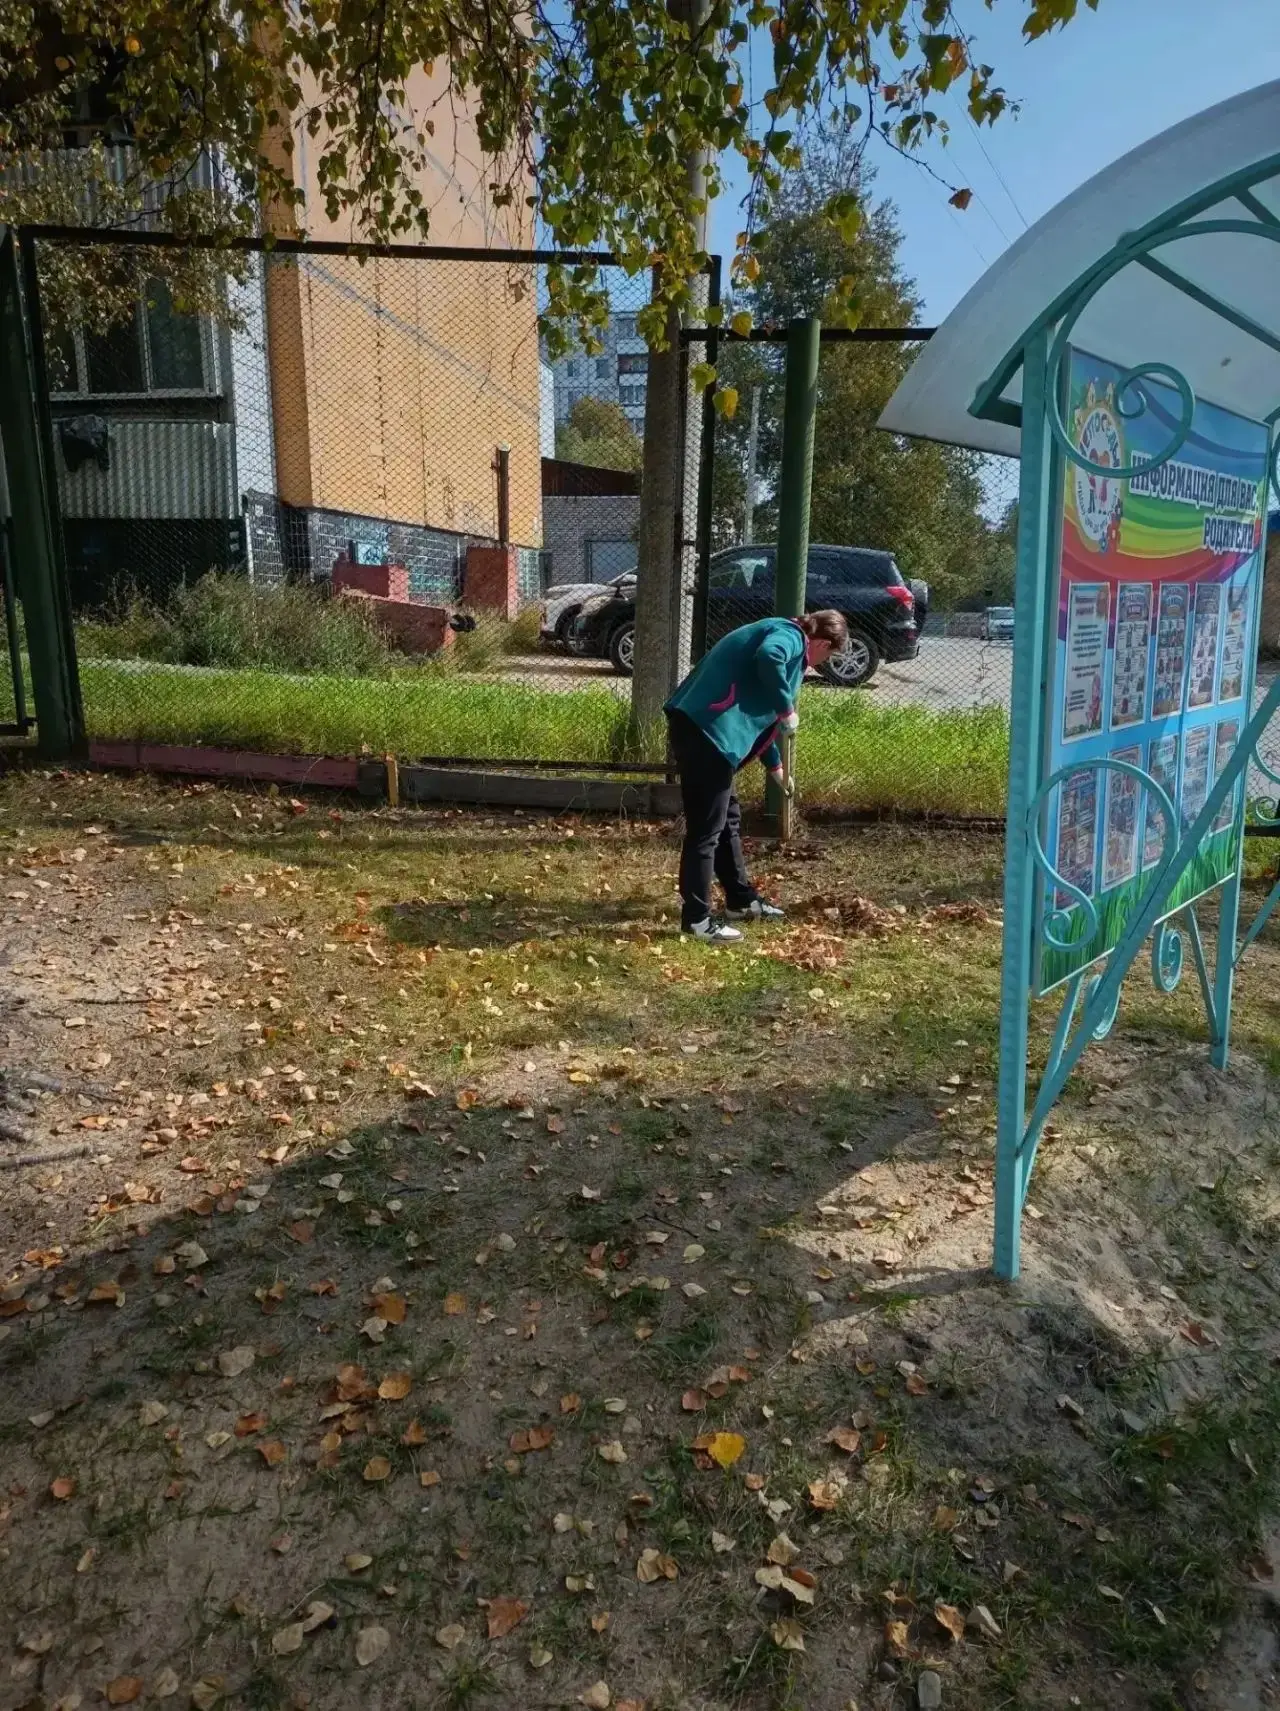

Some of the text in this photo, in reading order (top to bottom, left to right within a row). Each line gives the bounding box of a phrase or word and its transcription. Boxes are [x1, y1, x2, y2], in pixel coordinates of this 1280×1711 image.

[1131, 453, 1216, 508] ИНФОРМАЦИЯ
[1217, 476, 1238, 511] ДЛЯ
[1204, 517, 1254, 551] РОДИТЕЛИ
